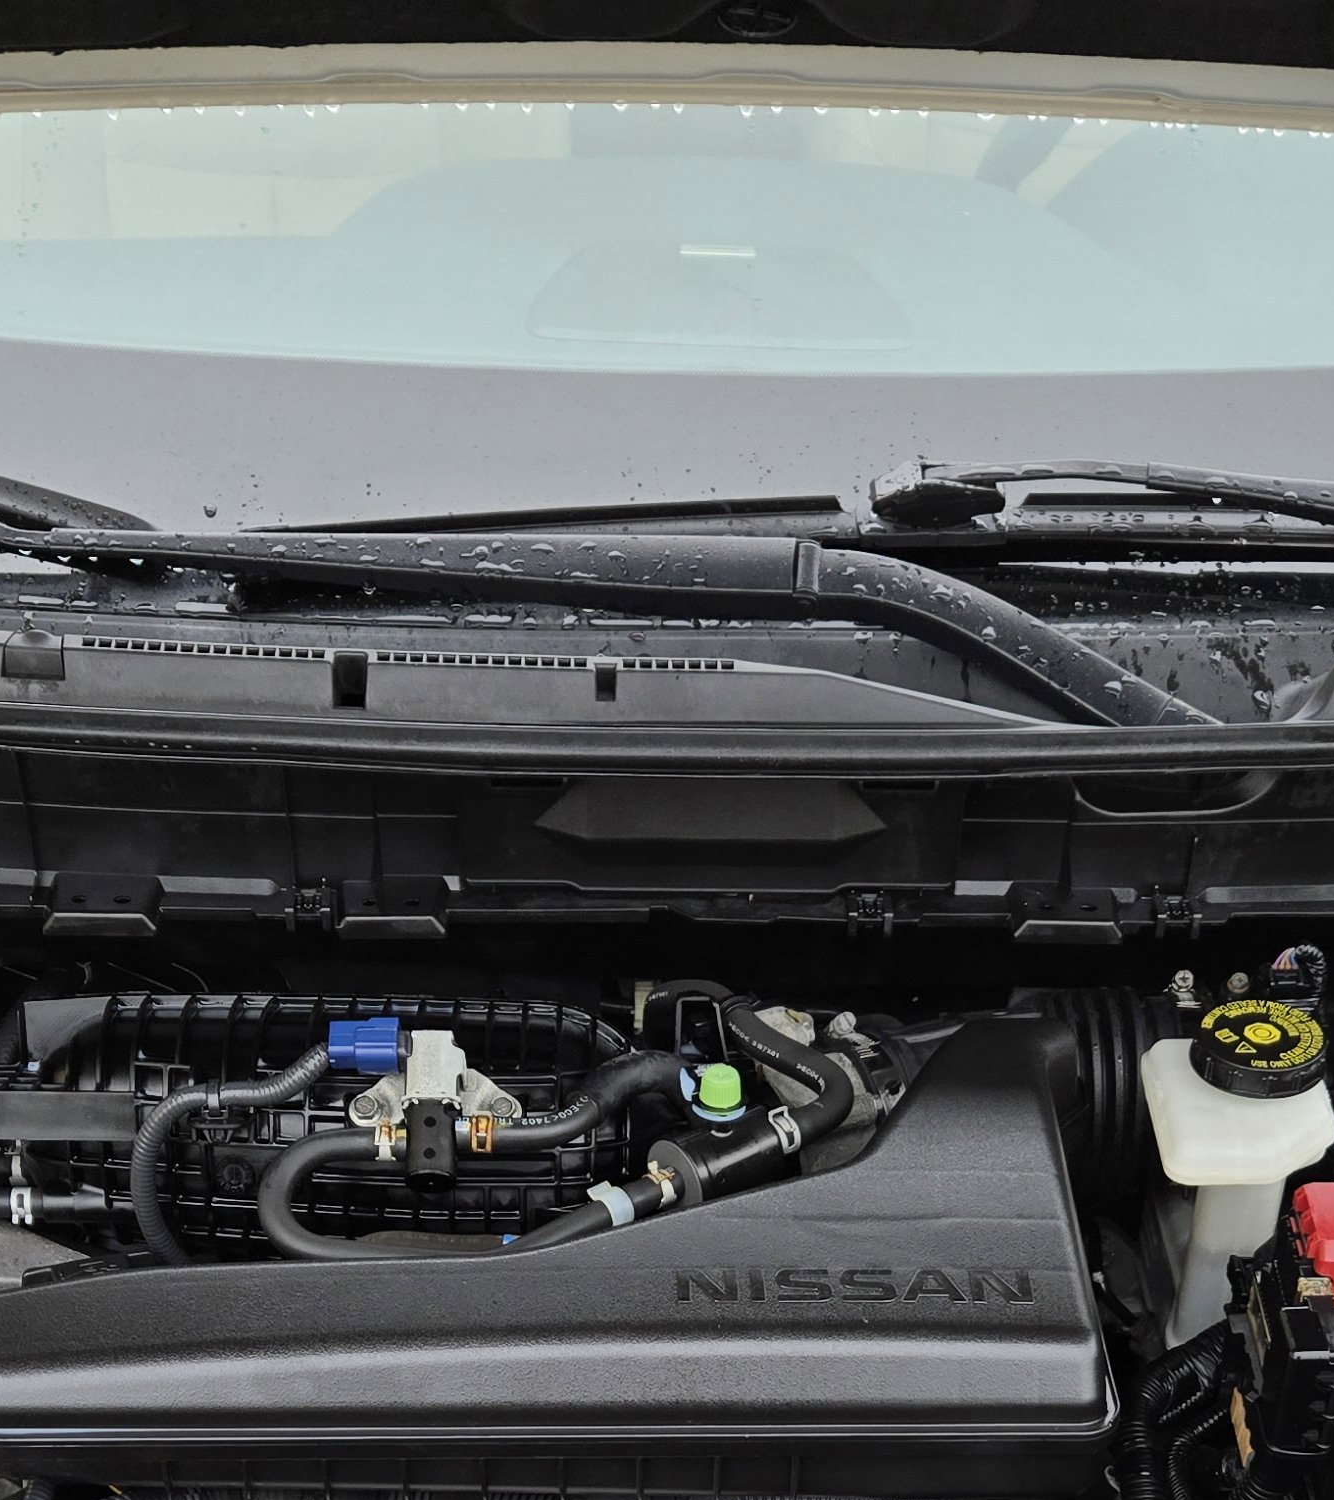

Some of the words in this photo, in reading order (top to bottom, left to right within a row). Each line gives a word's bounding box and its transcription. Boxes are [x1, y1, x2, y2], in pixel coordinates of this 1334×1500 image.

[1266, 1000, 1292, 1010] FROM
[1251, 1060, 1268, 1068] USE
[1269, 1059, 1293, 1068] ONLY
[675, 1268, 1036, 1305] NISSAN
